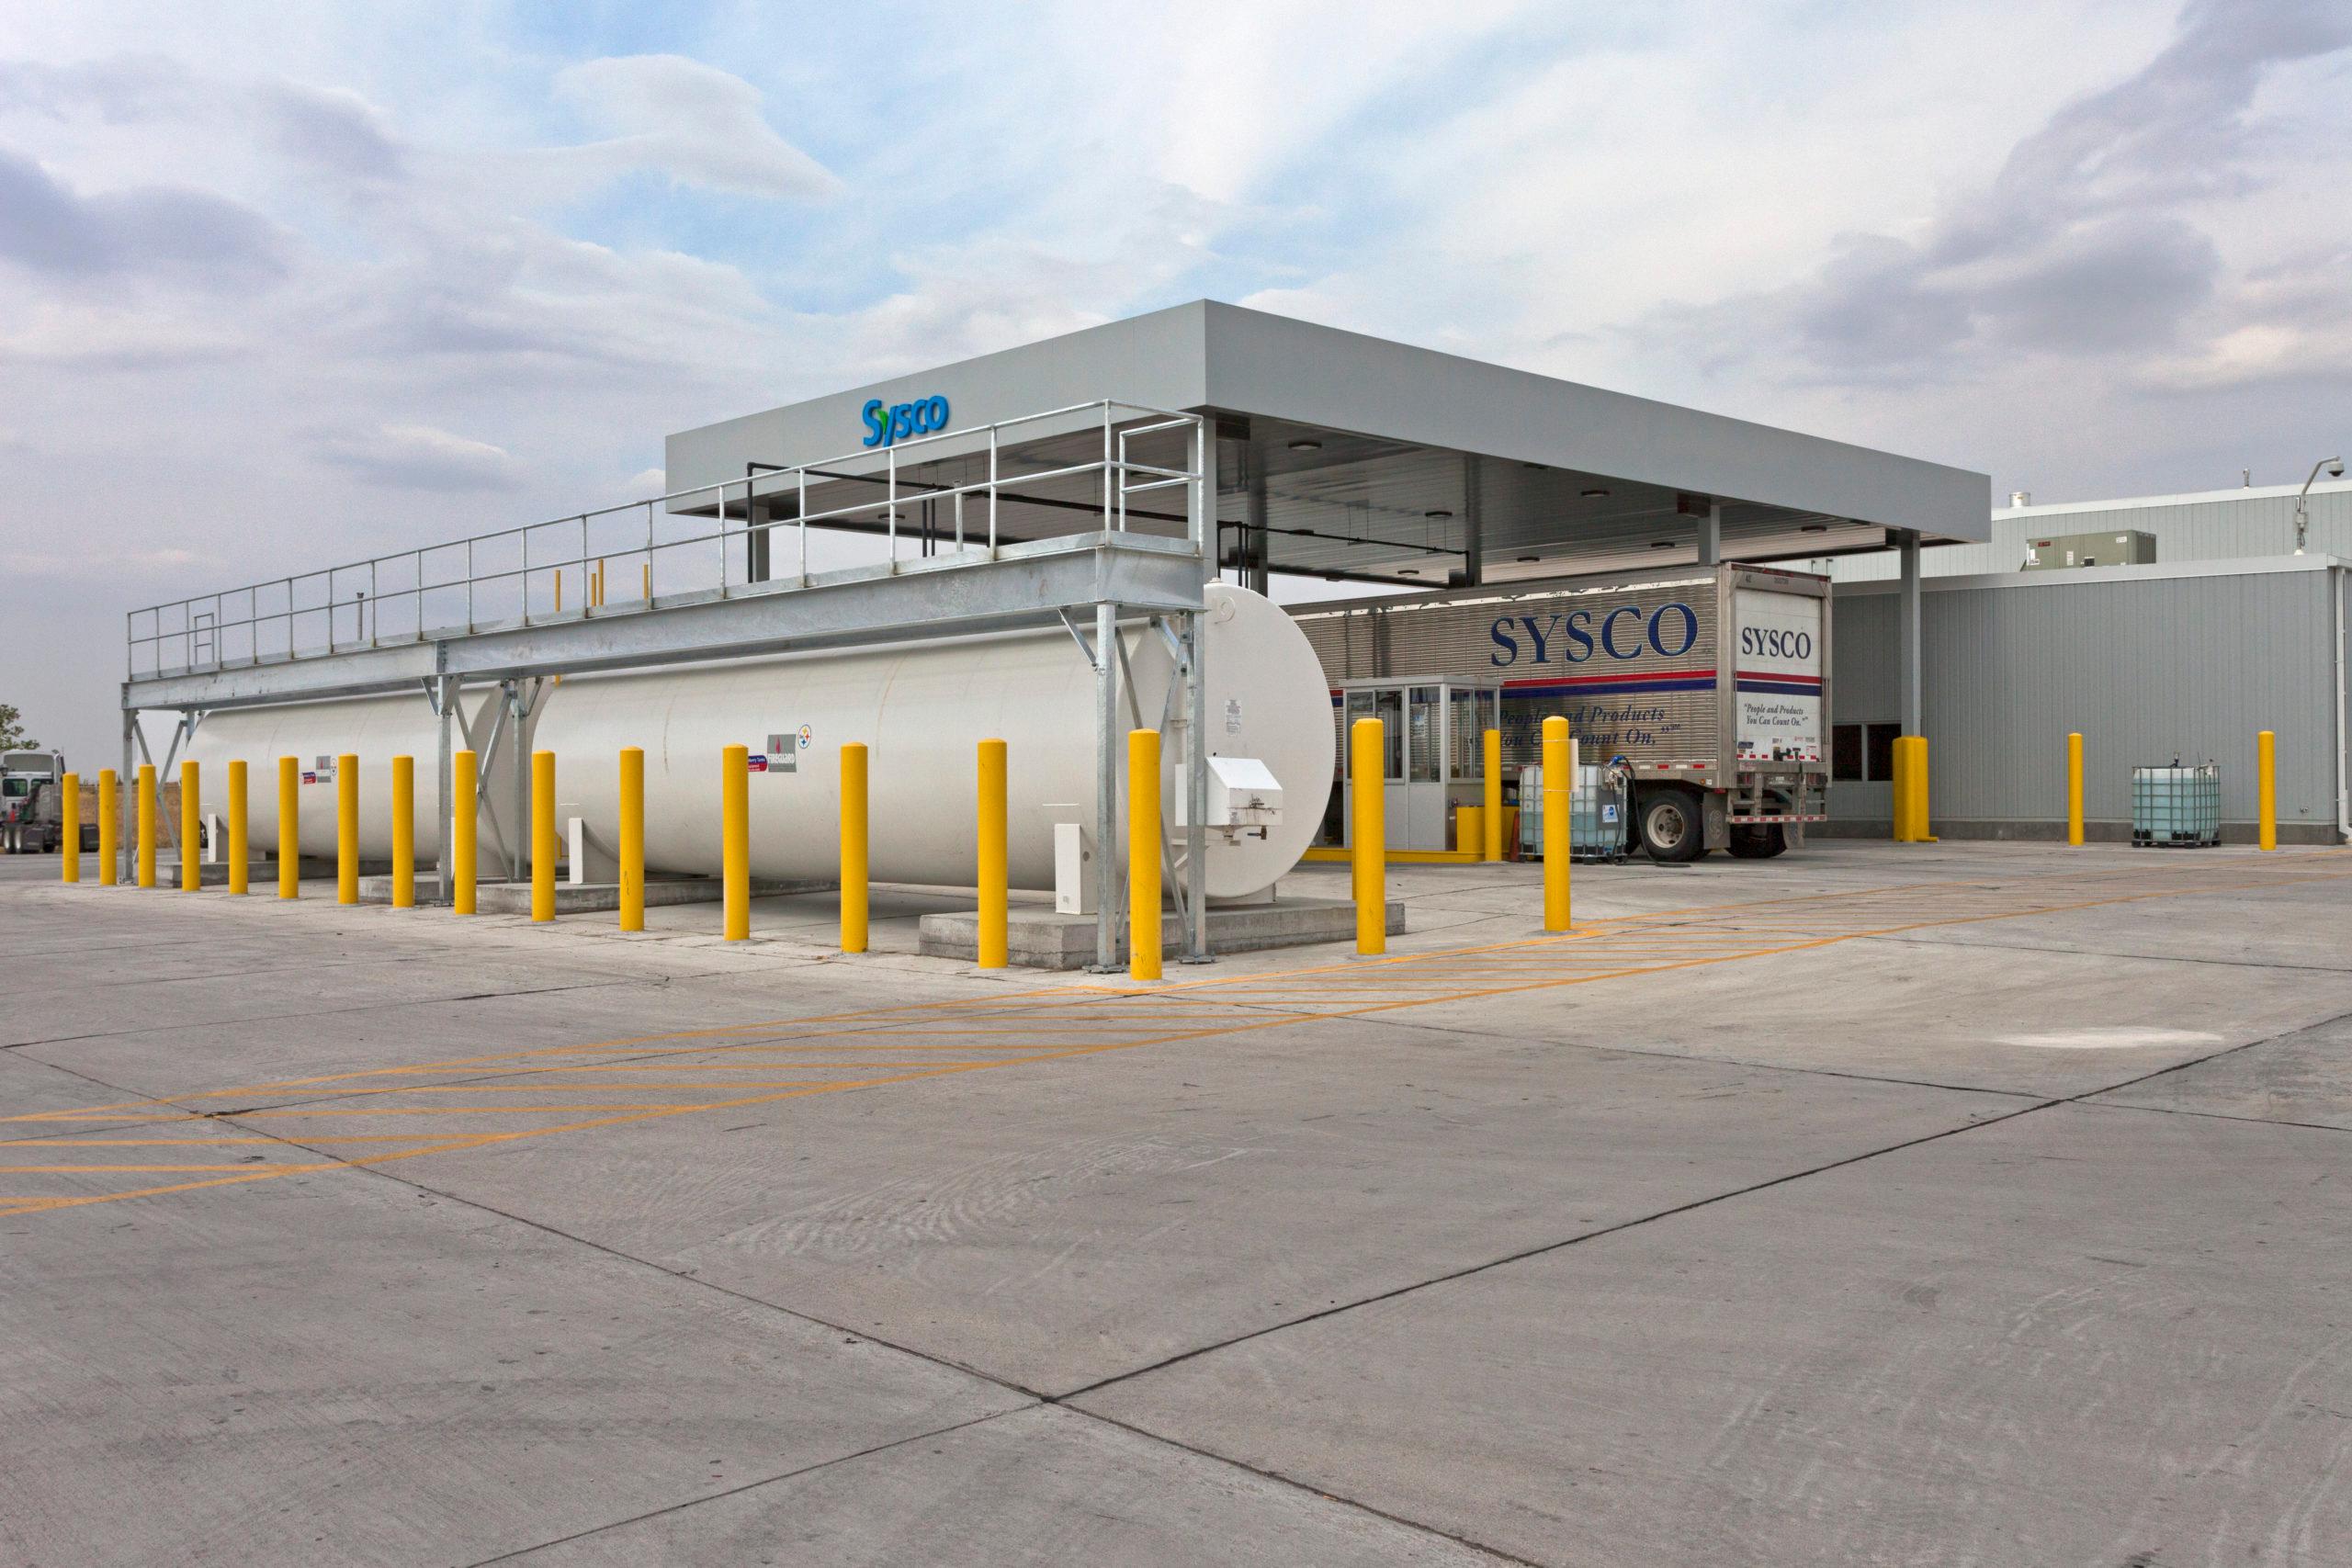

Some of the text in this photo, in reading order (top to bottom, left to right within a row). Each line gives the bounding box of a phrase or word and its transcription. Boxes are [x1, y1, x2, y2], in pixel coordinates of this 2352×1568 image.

[862, 395, 950, 448] Sysco
[1490, 602, 1699, 667] SYSCO
[1742, 626, 1811, 660] SYSCO
[1590, 705, 1665, 723] Products
[1747, 716, 1758, 725] You
[1758, 716, 1770, 726] Can
[1772, 716, 1790, 726] Count
[1767, 705, 1779, 714] and
[1780, 705, 1804, 716] Products
